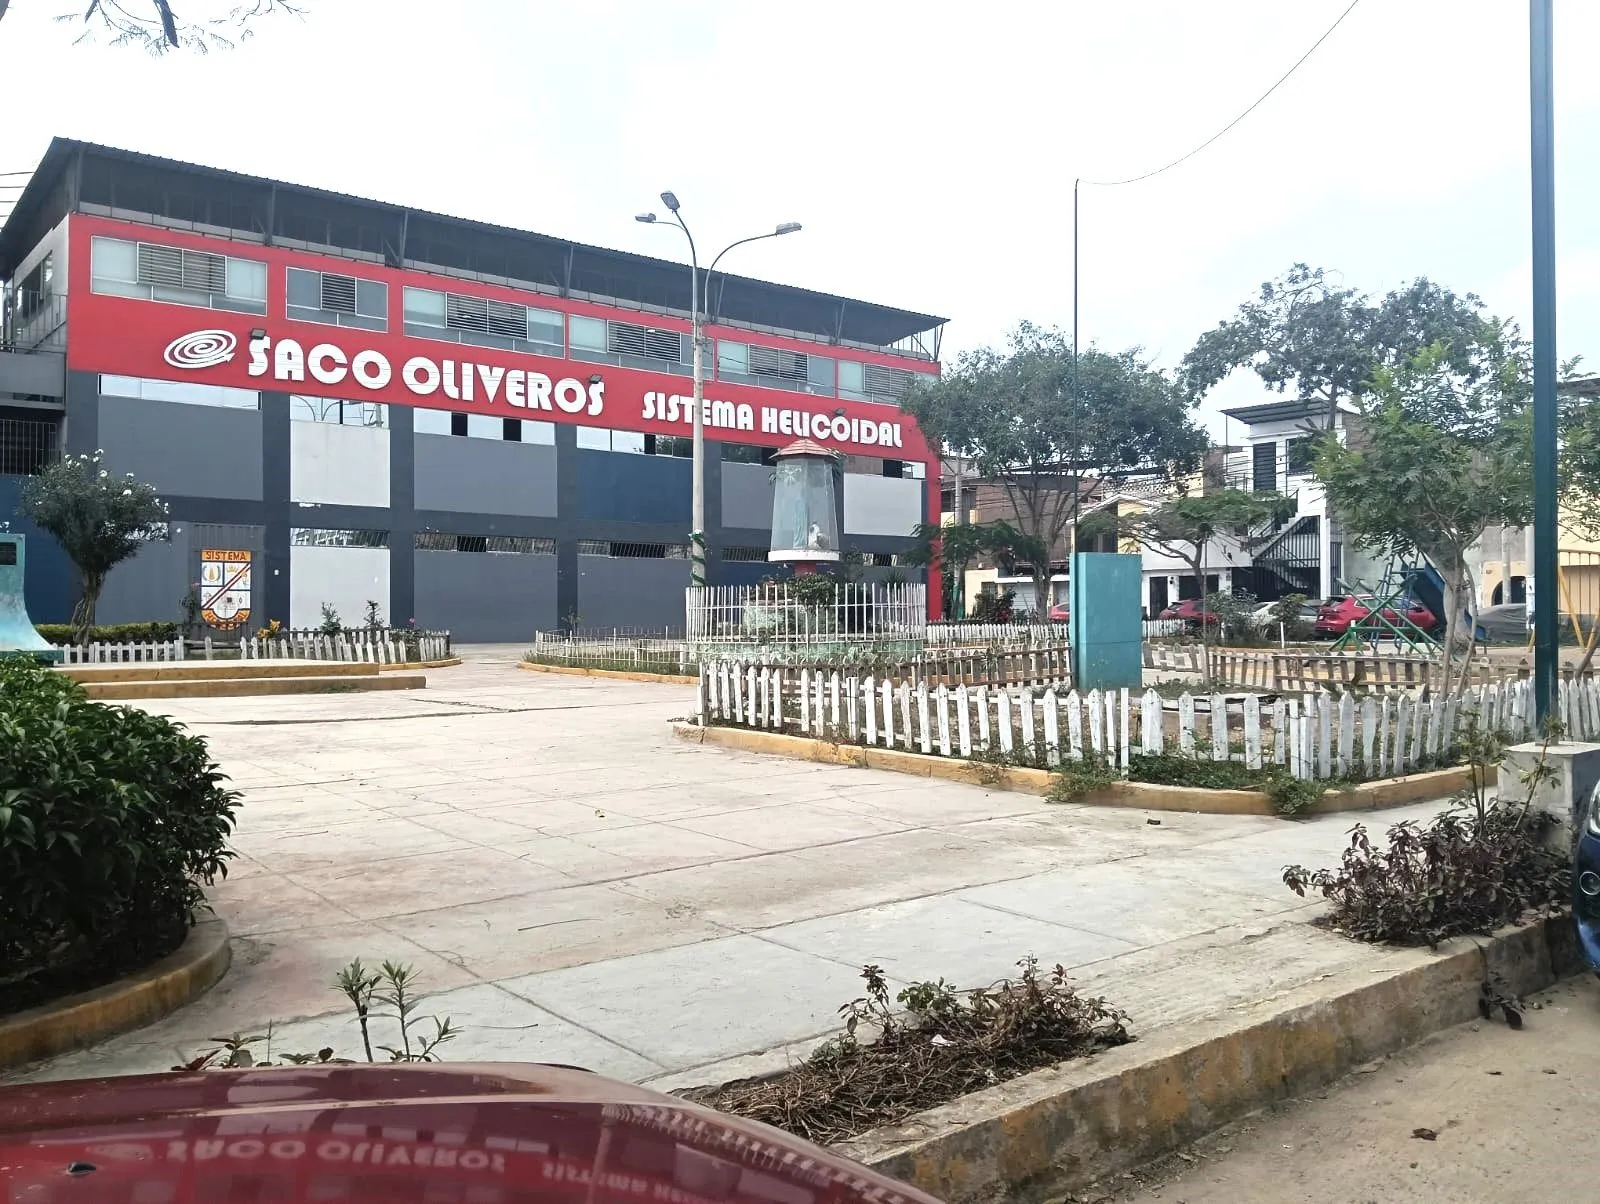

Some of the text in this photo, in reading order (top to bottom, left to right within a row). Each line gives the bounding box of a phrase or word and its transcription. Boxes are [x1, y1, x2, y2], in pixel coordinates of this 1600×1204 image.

[248, 335, 605, 416] SACO OLIVEROS
[642, 391, 902, 448] SISTEMA HELICOIDAL
[205, 551, 246, 560] SISTEMA
